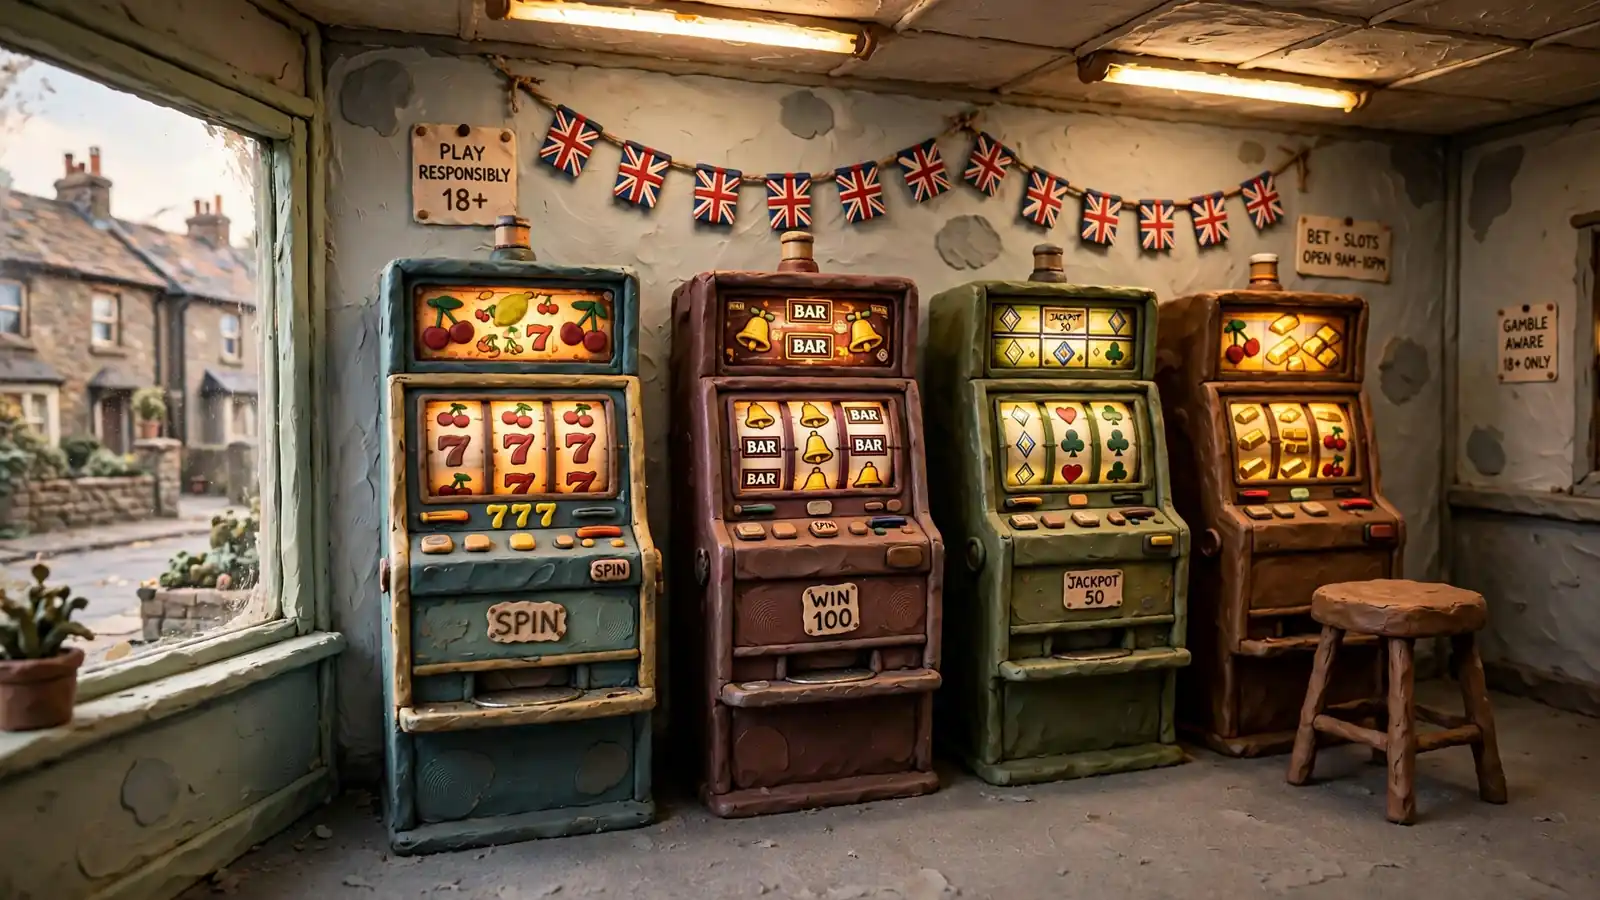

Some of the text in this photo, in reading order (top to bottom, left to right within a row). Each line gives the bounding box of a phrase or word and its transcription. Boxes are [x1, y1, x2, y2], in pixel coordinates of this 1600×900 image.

[440, 142, 485, 161] PLAY
[419, 164, 511, 183] RESPONSIBLY
[442, 188, 488, 211] 18+
[1307, 228, 1379, 250] BET SLOTS
[1303, 250, 1331, 265] OPEN
[794, 304, 826, 319] BAR
[1049, 313, 1082, 321] JACKPOT
[1503, 316, 1548, 333] GAMBLE
[526, 323, 553, 351] 7
[1505, 334, 1544, 351] AWARE
[793, 339, 827, 354] BAR
[1503, 355, 1551, 372] 18+ ONLY
[850, 409, 879, 421] BAR
[438, 433, 596, 467] 7 7 7
[746, 440, 776, 454] BAR
[855, 439, 883, 451] BAR
[746, 473, 776, 485] BAR
[486, 503, 557, 529] 777
[594, 563, 626, 578] SPIN
[1067, 574, 1120, 589] JACKPOT
[810, 589, 850, 608] WIN
[1084, 590, 1104, 605] 50
[494, 609, 559, 636] SPIN
[813, 608, 852, 631] 100
